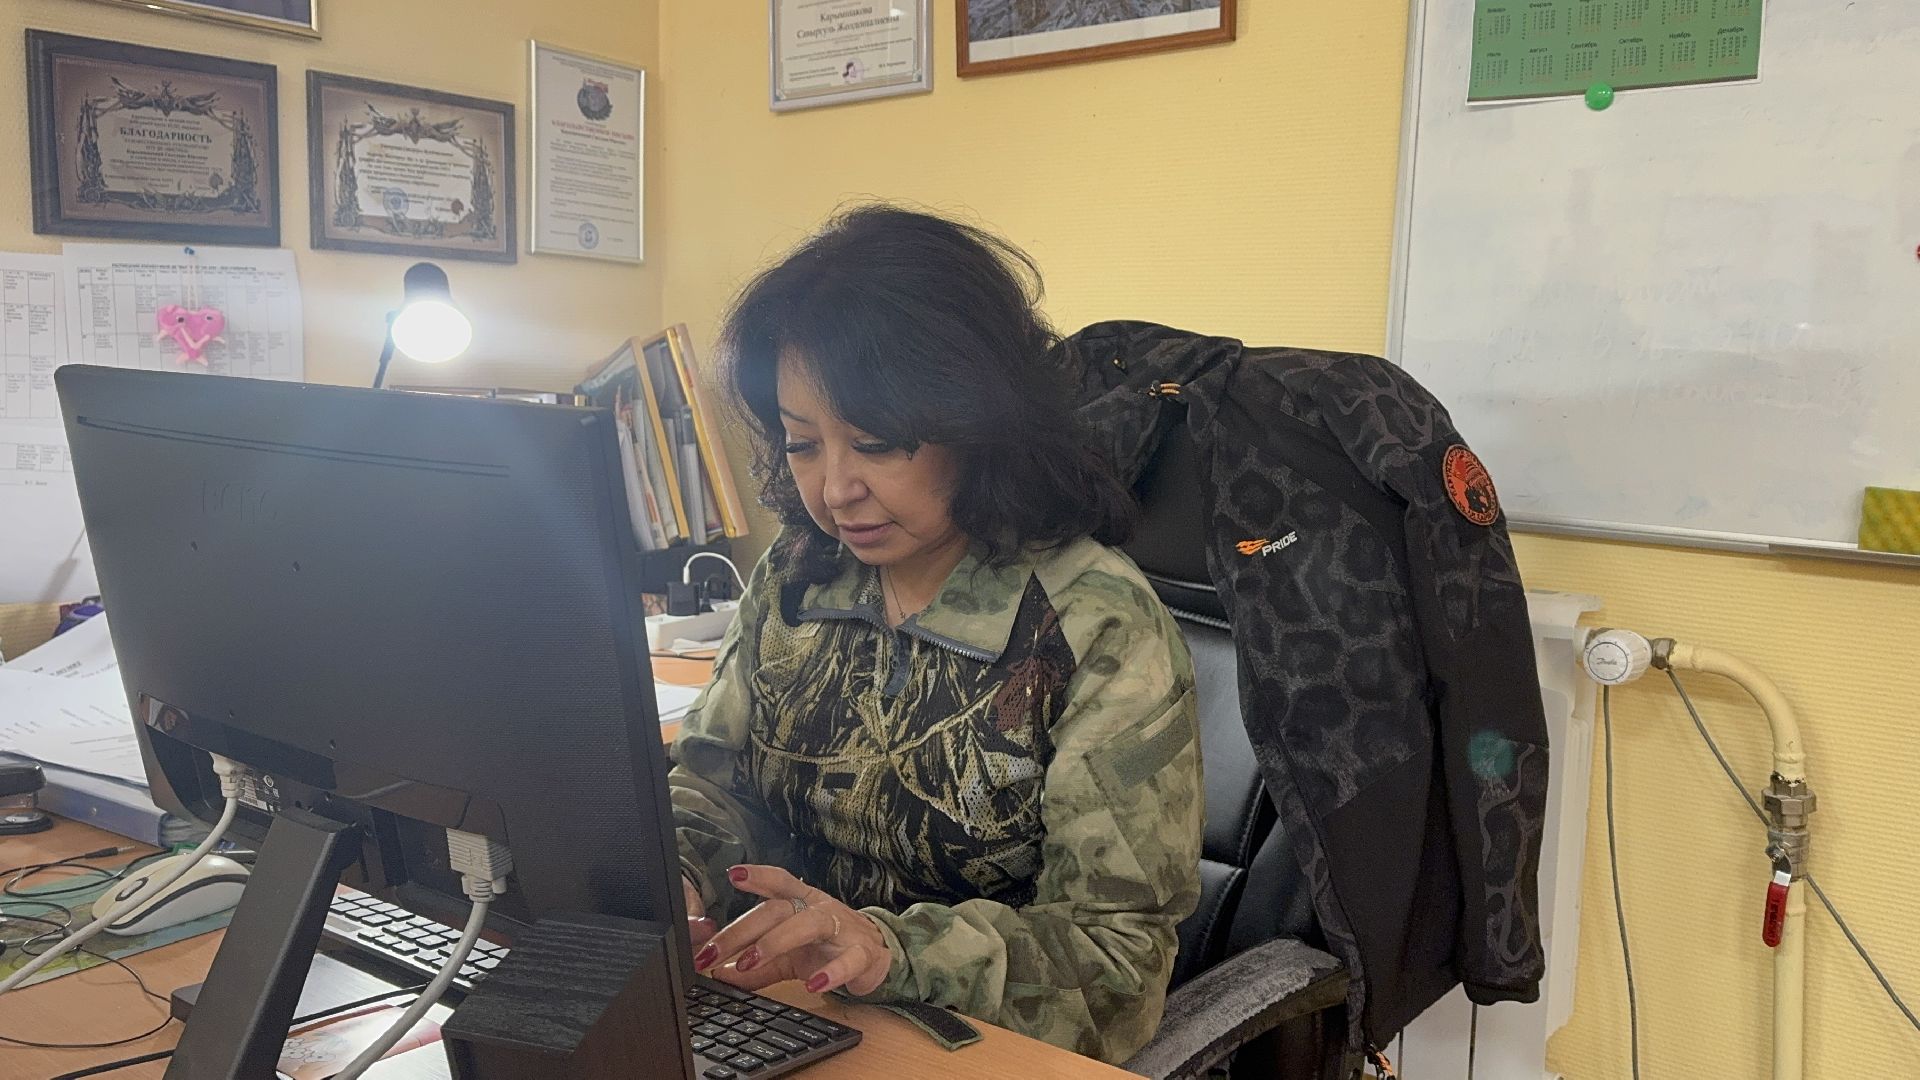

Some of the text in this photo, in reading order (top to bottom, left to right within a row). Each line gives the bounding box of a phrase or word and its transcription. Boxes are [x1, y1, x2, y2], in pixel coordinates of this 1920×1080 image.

[1717, 26, 1745, 36] Декабрь
[120, 127, 212, 144] БЛАГОДАРНОСТЬ
[1261, 530, 1298, 557] PRIDE
